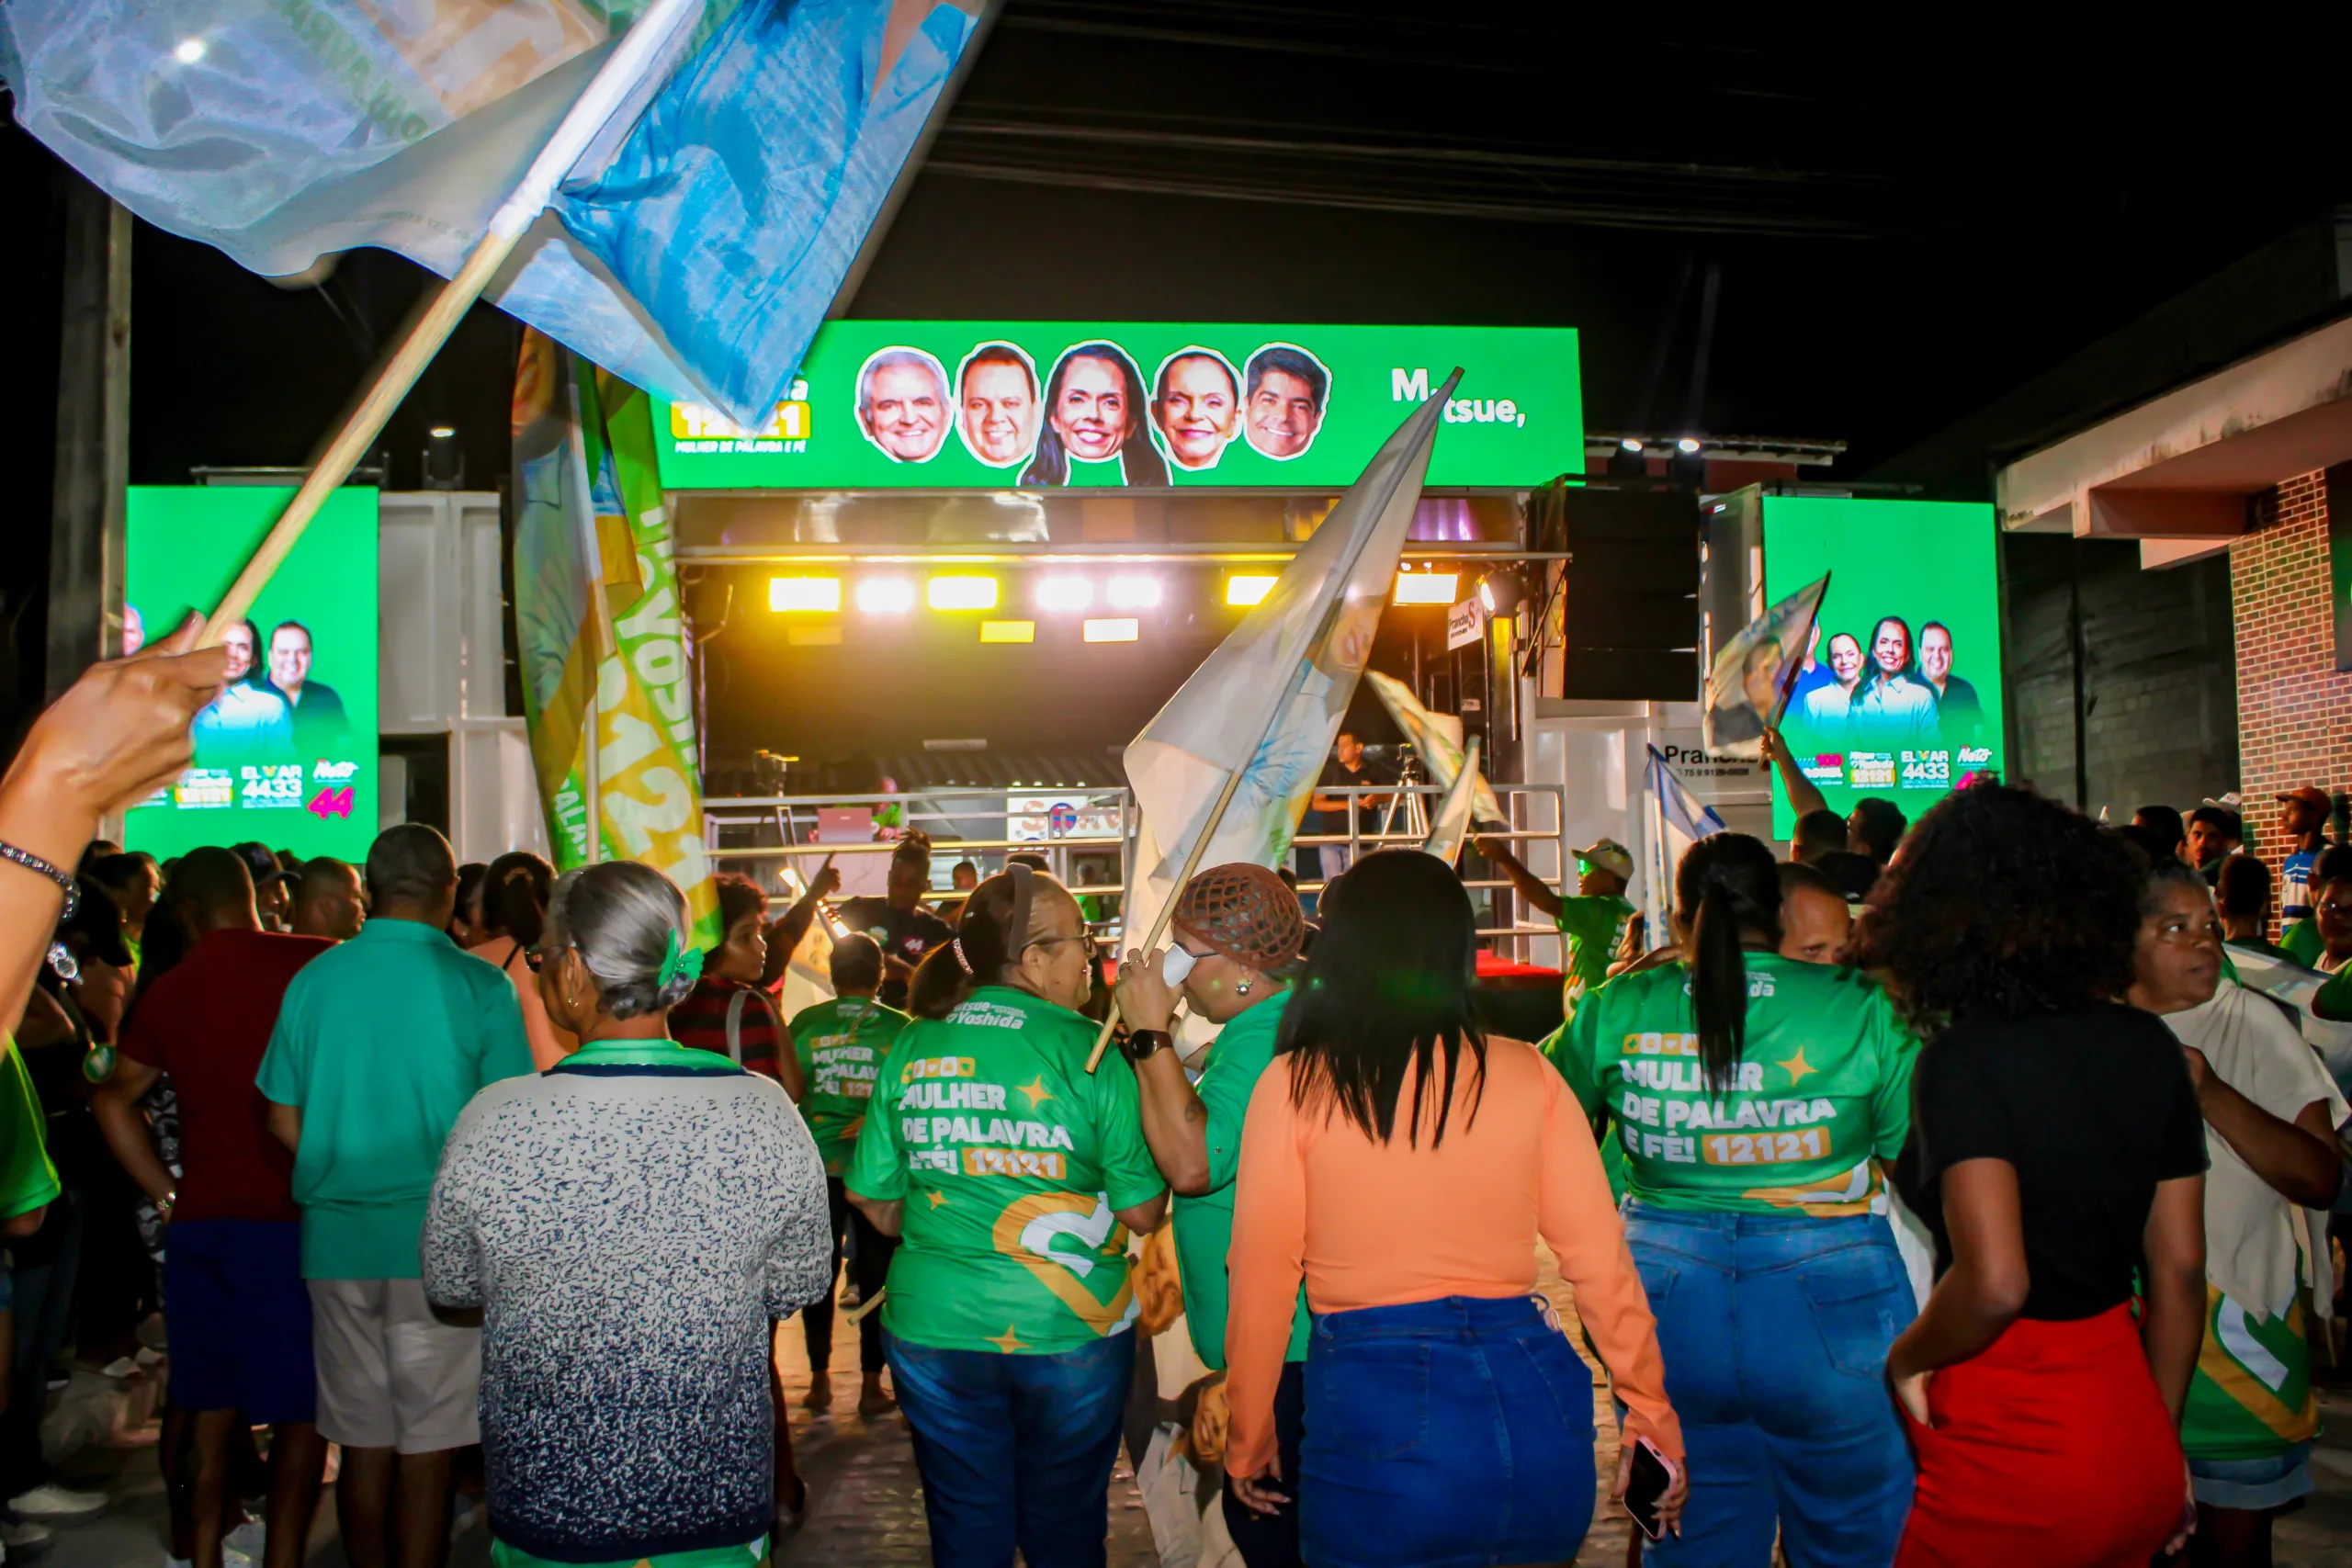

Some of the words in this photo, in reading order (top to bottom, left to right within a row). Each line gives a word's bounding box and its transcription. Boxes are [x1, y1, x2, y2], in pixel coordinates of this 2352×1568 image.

[1902, 762, 1950, 779] 4433
[241, 779, 302, 798] 4433
[307, 786, 355, 819] 44
[957, 1011, 1024, 1030] Yoshida
[1622, 1091, 1660, 1127] DE
[1666, 1098, 1838, 1129] PALAVRA
[902, 1117, 929, 1144] DE
[932, 1117, 1074, 1151] PALAVRA
[1624, 1124, 1640, 1155] E
[1643, 1130, 1697, 1164] FÉ!
[1710, 1130, 1822, 1164] 12121
[970, 1149, 1058, 1178] 12121
